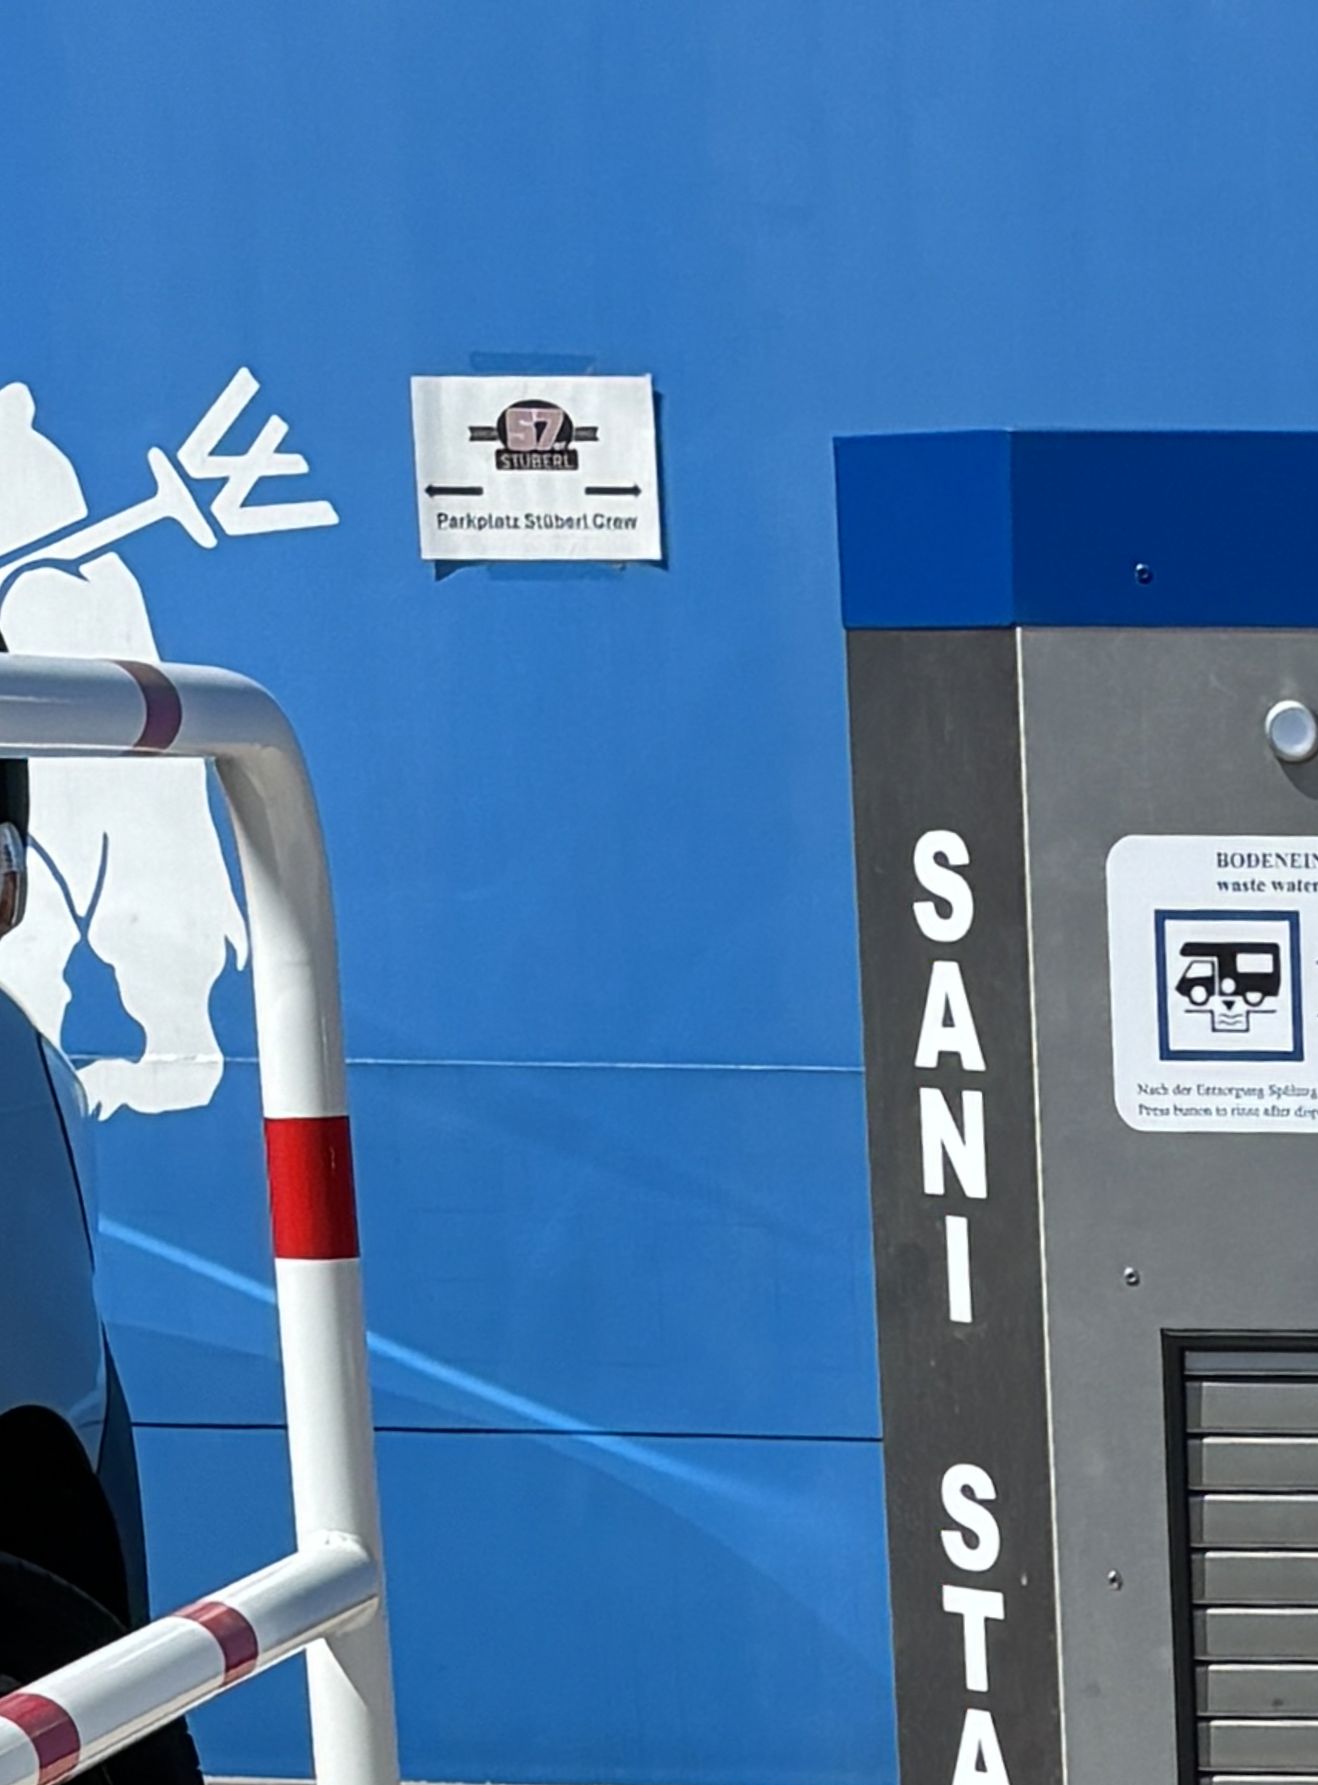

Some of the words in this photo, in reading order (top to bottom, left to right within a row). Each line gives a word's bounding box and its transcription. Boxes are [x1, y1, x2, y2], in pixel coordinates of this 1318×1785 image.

[436, 512, 519, 531] Parkplatz
[592, 513, 638, 530] Crew
[1217, 879, 1267, 893] waste
[912, 829, 988, 1324] SANI
[1137, 1083, 1169, 1096] Nach
